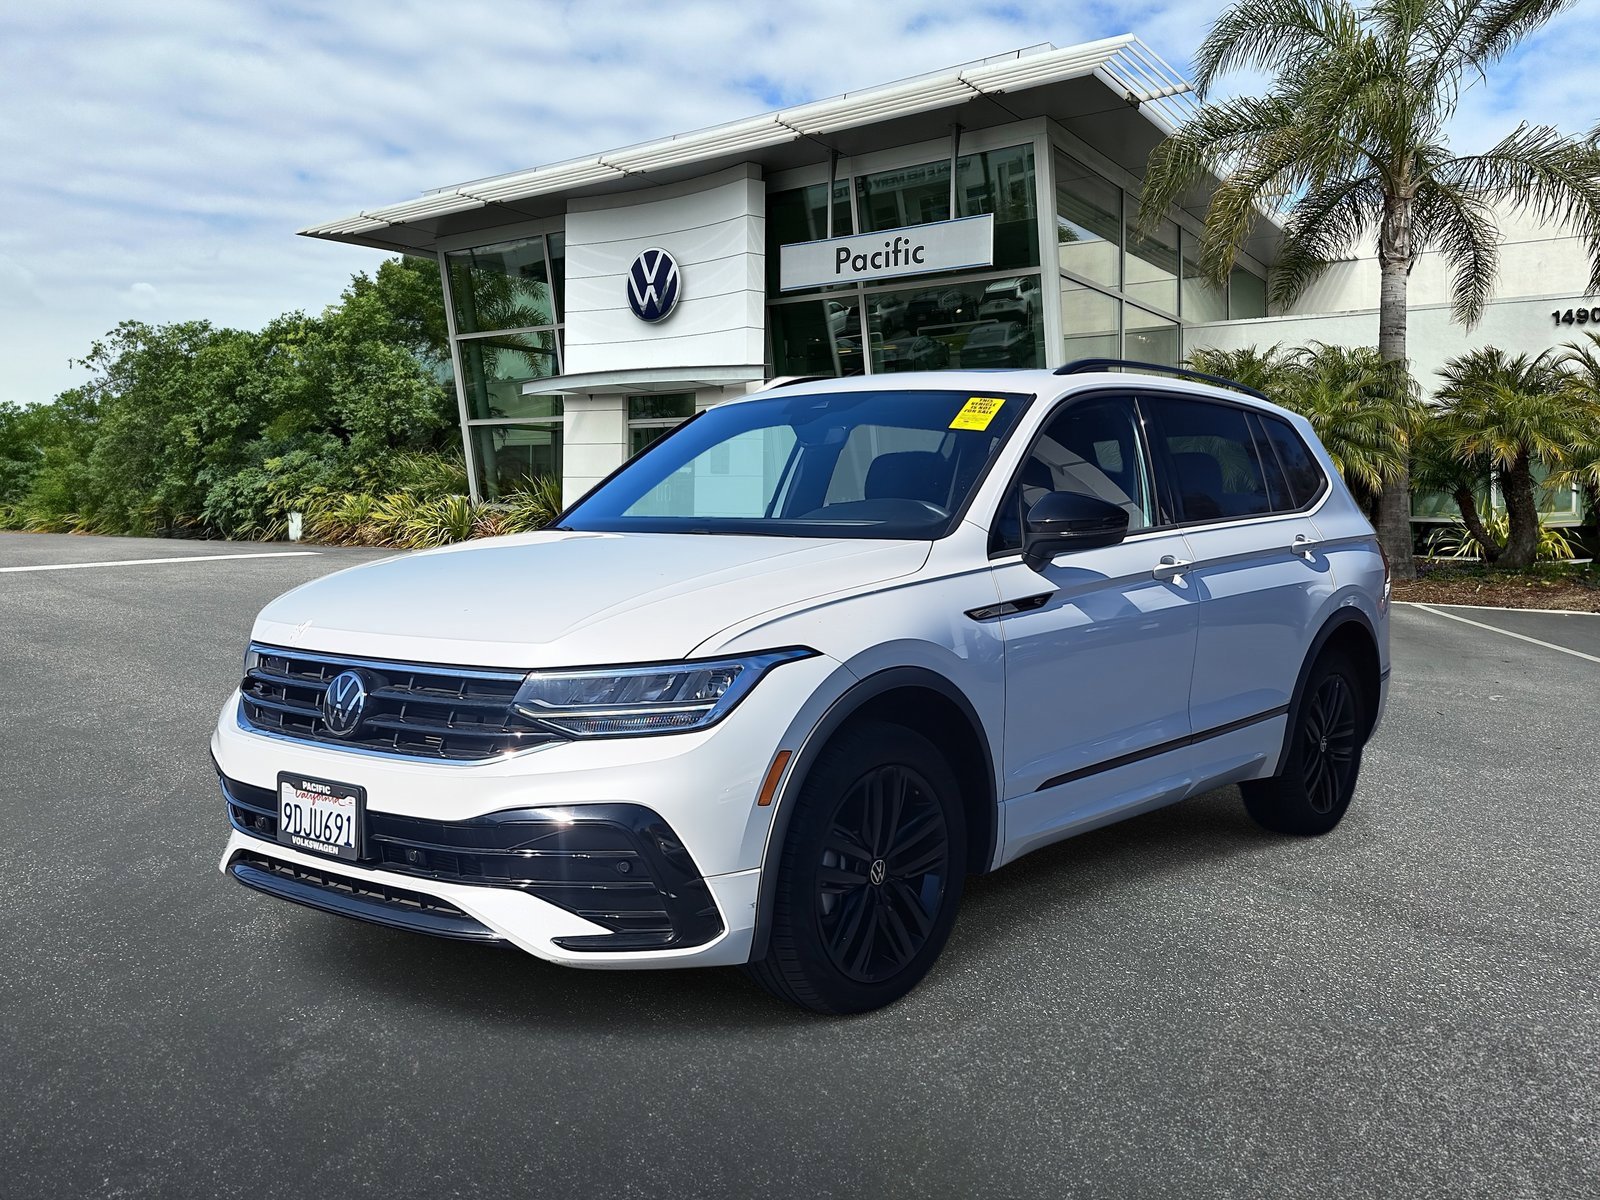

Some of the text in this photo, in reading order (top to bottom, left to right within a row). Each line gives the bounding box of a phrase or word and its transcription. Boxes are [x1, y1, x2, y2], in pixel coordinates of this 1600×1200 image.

[835, 237, 925, 274] Pacific
[627, 248, 680, 320] VW
[1551, 307, 1600, 326] 1490
[324, 672, 364, 734] VW
[302, 781, 331, 795] PACIFIC
[284, 802, 353, 848] 9DJU691
[291, 835, 339, 855] VOLKSWAGEN
